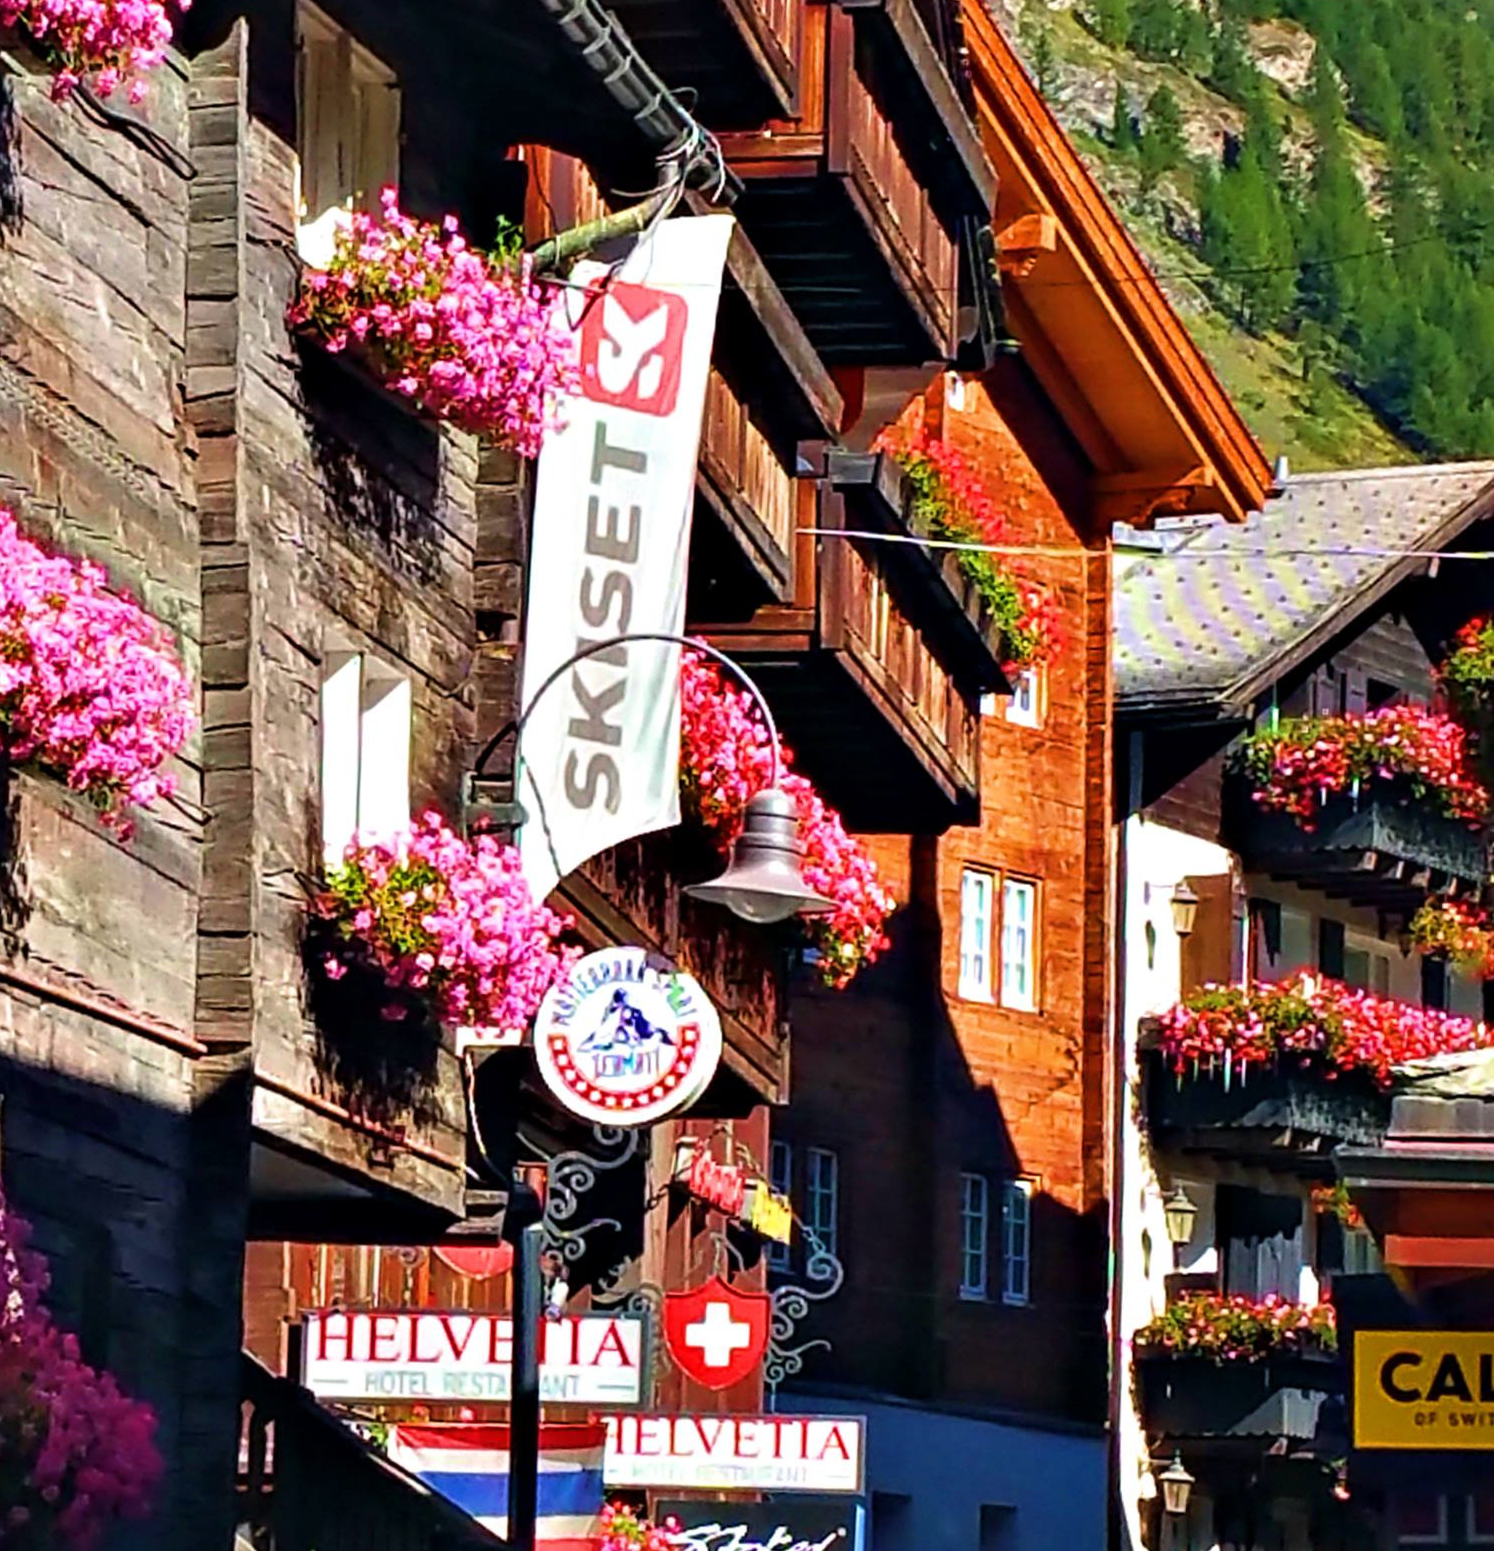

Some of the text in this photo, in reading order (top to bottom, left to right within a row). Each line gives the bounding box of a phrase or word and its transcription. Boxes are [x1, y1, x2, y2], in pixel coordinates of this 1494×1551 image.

[563, 420, 648, 816] SKISET
[364, 1371, 582, 1399] HOTEL RESTAANT
